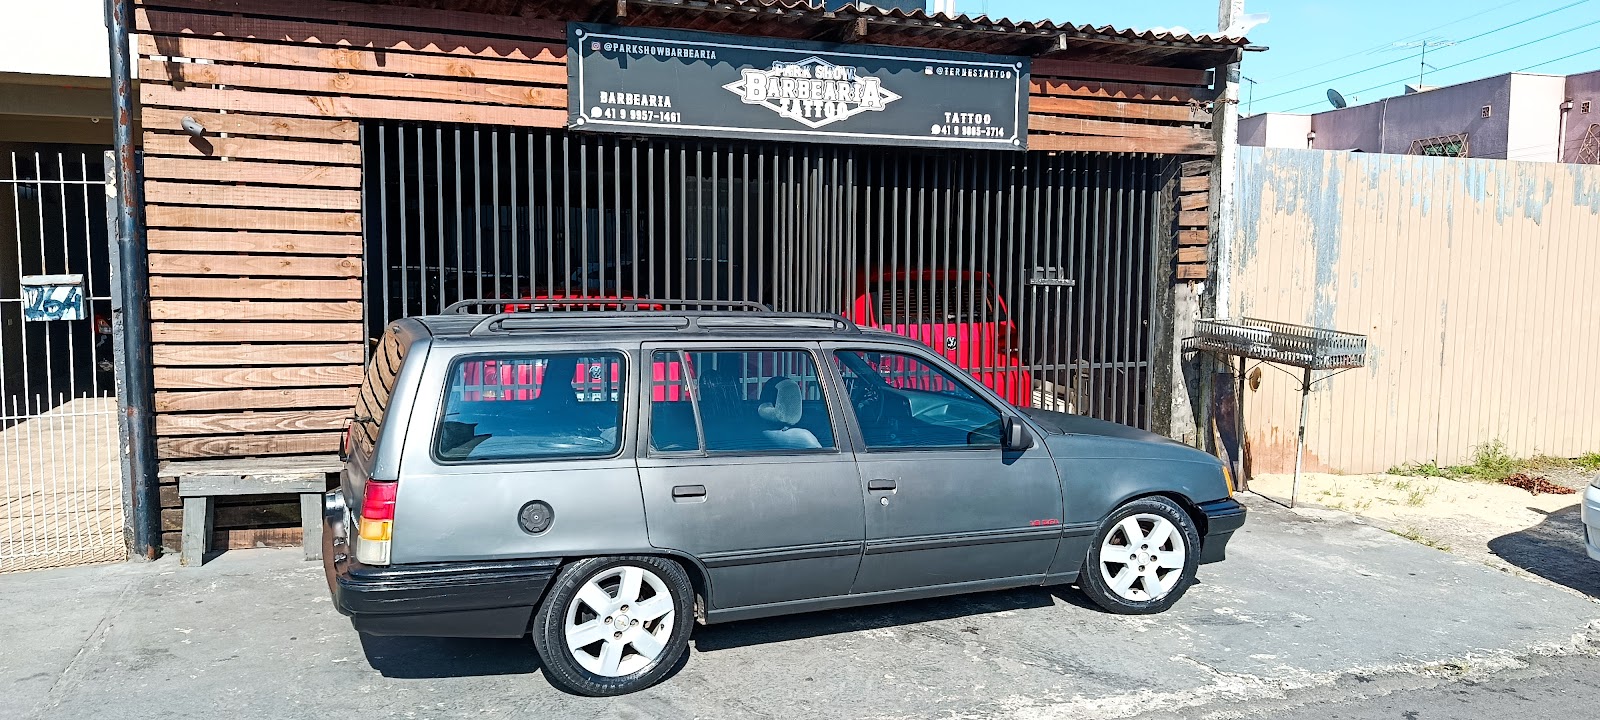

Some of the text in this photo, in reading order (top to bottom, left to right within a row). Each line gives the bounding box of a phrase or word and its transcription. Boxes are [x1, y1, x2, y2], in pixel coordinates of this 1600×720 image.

[603, 42, 717, 60] @PARKSHOWBARBEARIA
[774, 63, 856, 81] PARK SHOW
[743, 70, 883, 109] BARBEARIA
[599, 91, 672, 108] BARBEARIA
[604, 107, 616, 119] 41
[619, 108, 627, 120] 9
[780, 98, 848, 119] TATTOO
[944, 111, 992, 125] TATTOO
[941, 124, 951, 135] 41
